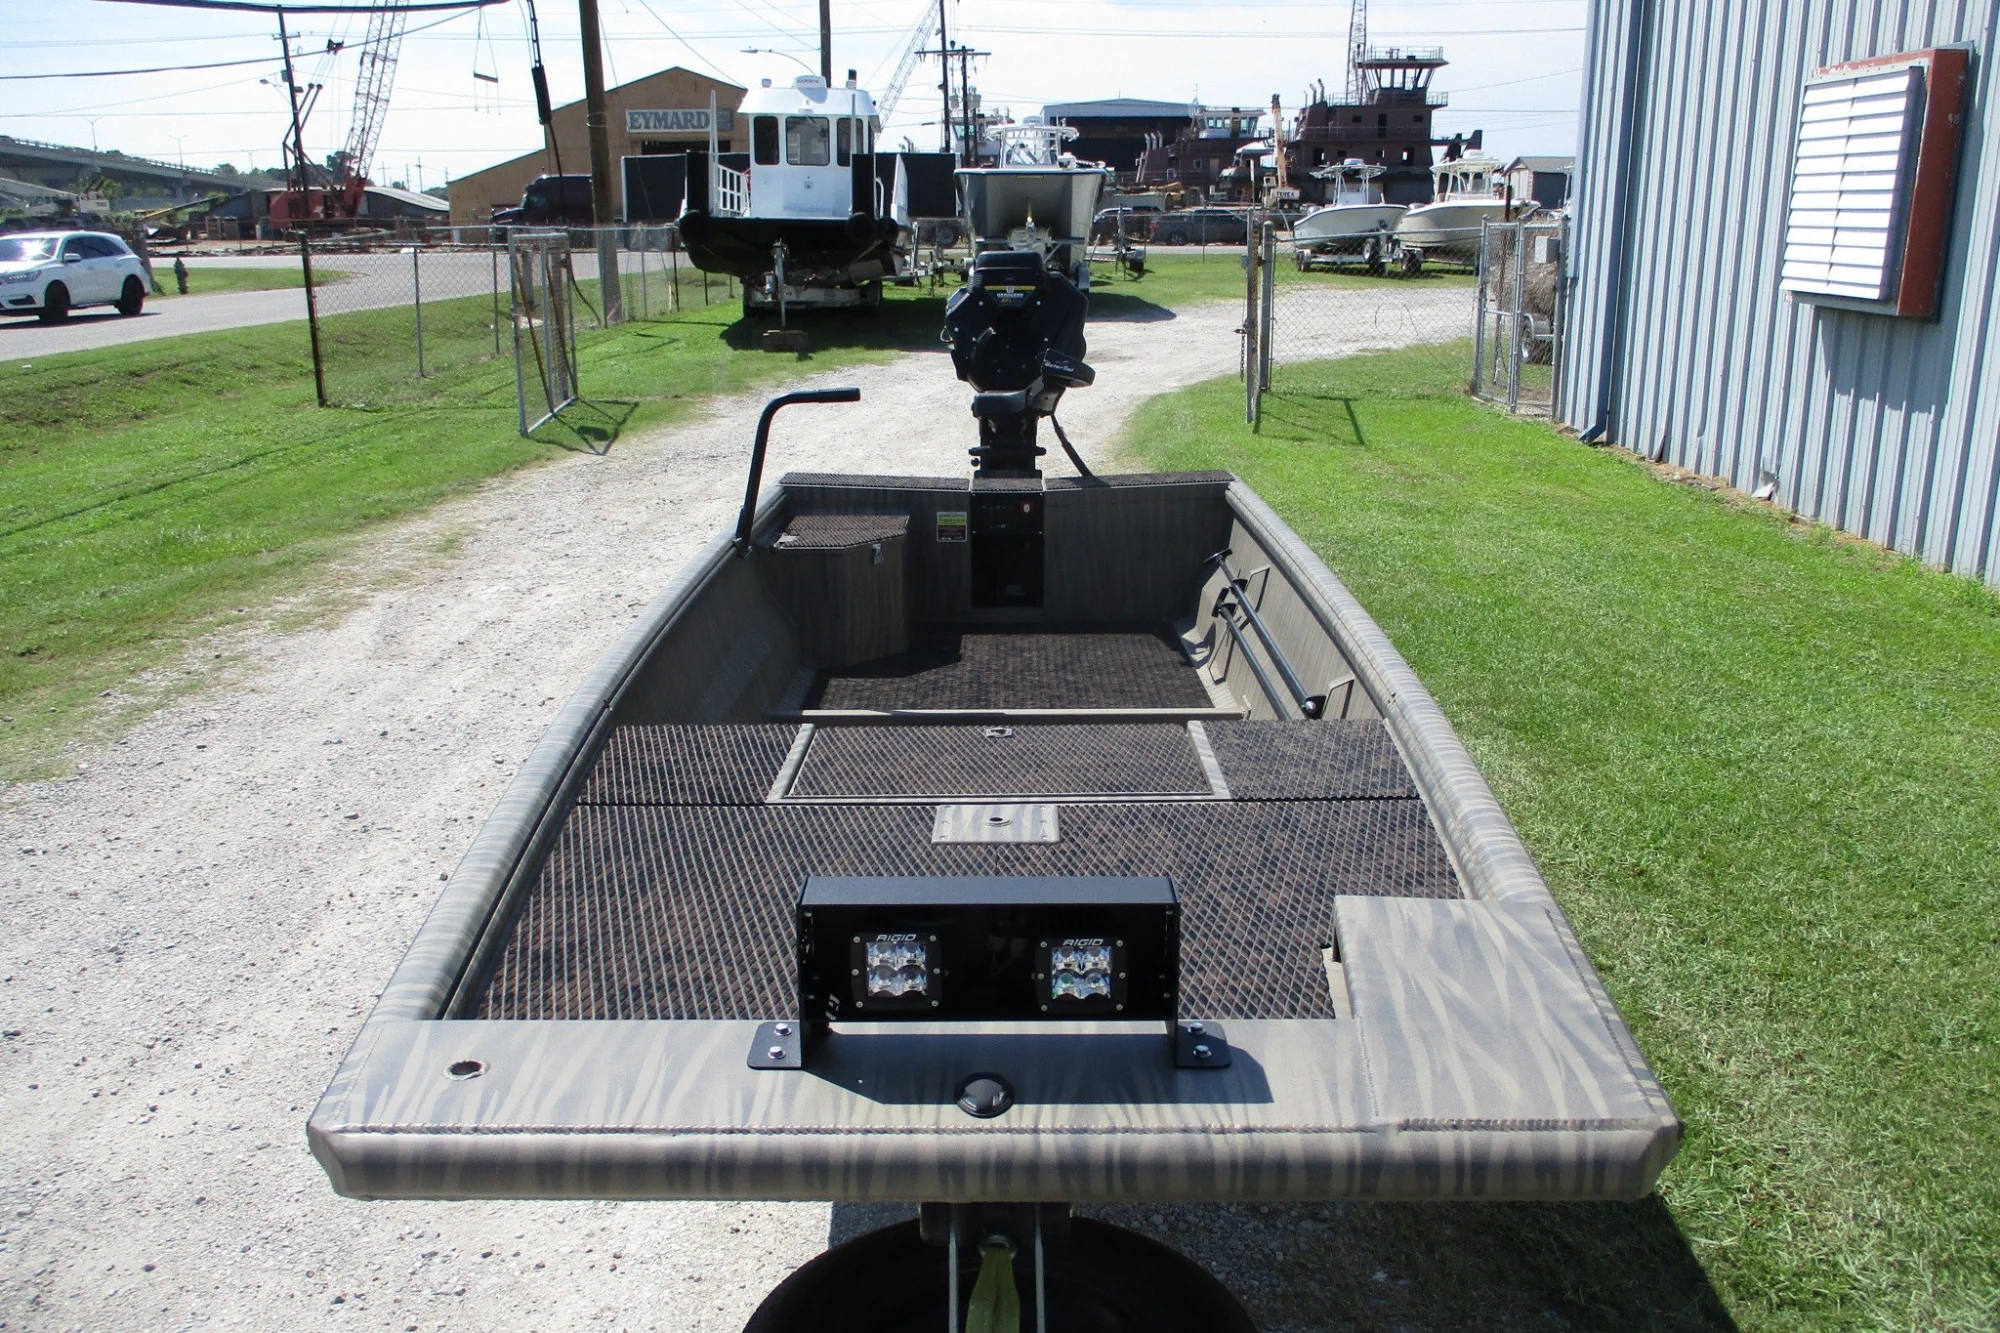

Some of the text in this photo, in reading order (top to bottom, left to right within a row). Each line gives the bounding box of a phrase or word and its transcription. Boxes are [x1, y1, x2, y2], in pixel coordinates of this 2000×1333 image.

[628, 111, 711, 130] EYMARD
[876, 934, 917, 942] RIGID
[1062, 938, 1104, 947] RIGID
